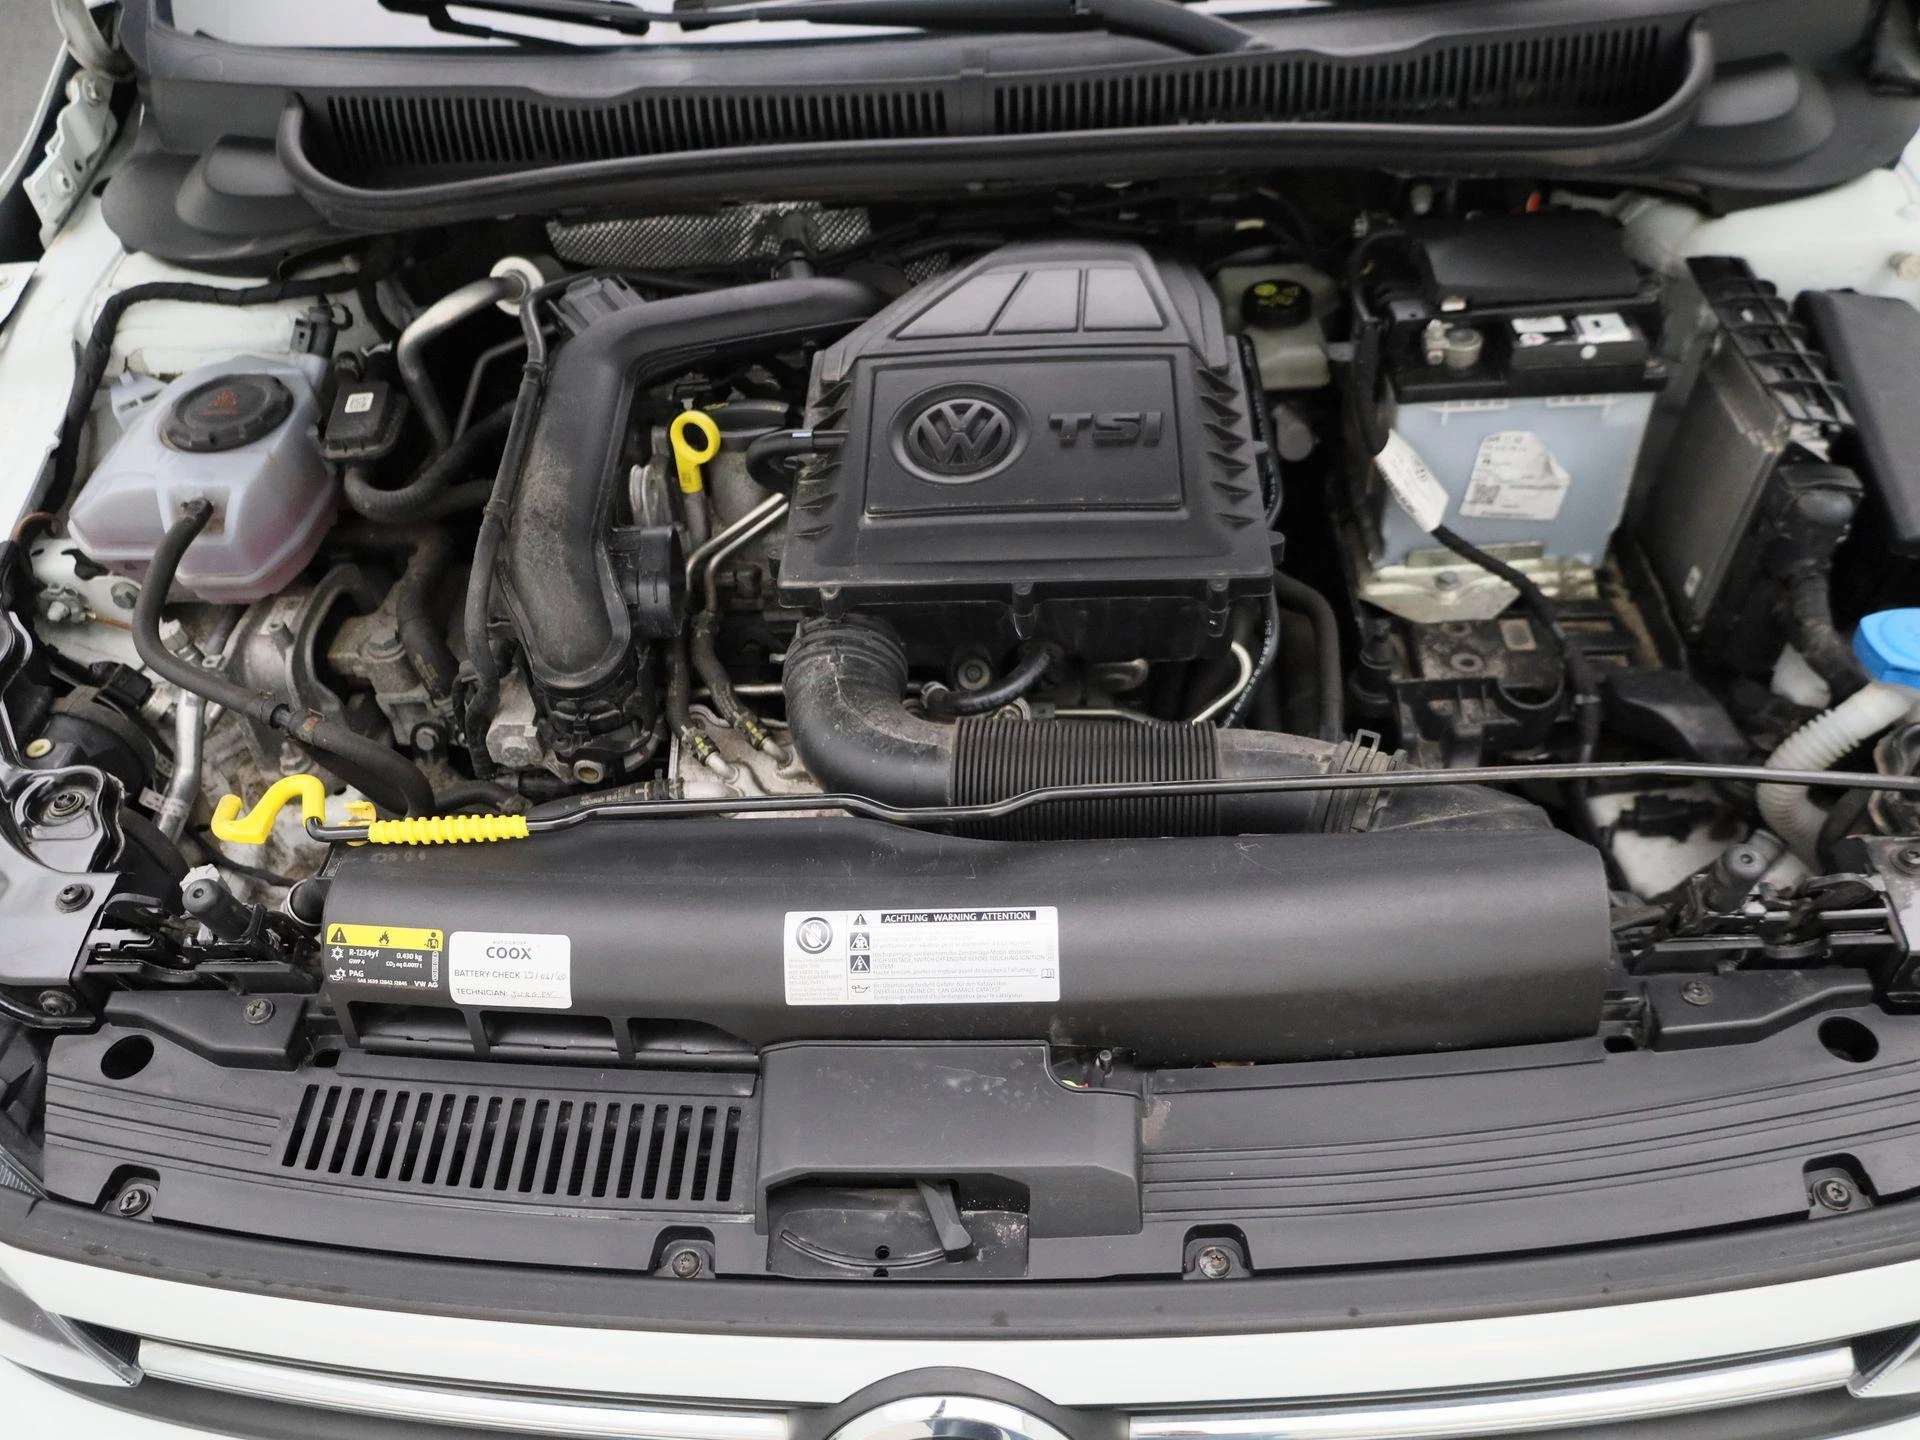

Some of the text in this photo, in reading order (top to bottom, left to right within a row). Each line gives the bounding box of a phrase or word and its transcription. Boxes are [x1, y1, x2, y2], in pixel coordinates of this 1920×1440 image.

[1049, 411, 1162, 447] TSI
[884, 911, 1031, 923] ACHTUNG WARNING ATTENTION
[348, 948, 380, 959] R-1234yf
[414, 953, 423, 962] kg
[486, 947, 532, 960] COOX
[348, 969, 364, 978] PAG
[454, 969, 490, 978] BATTERY
[414, 980, 427, 988] VW
[427, 981, 439, 989] AG
